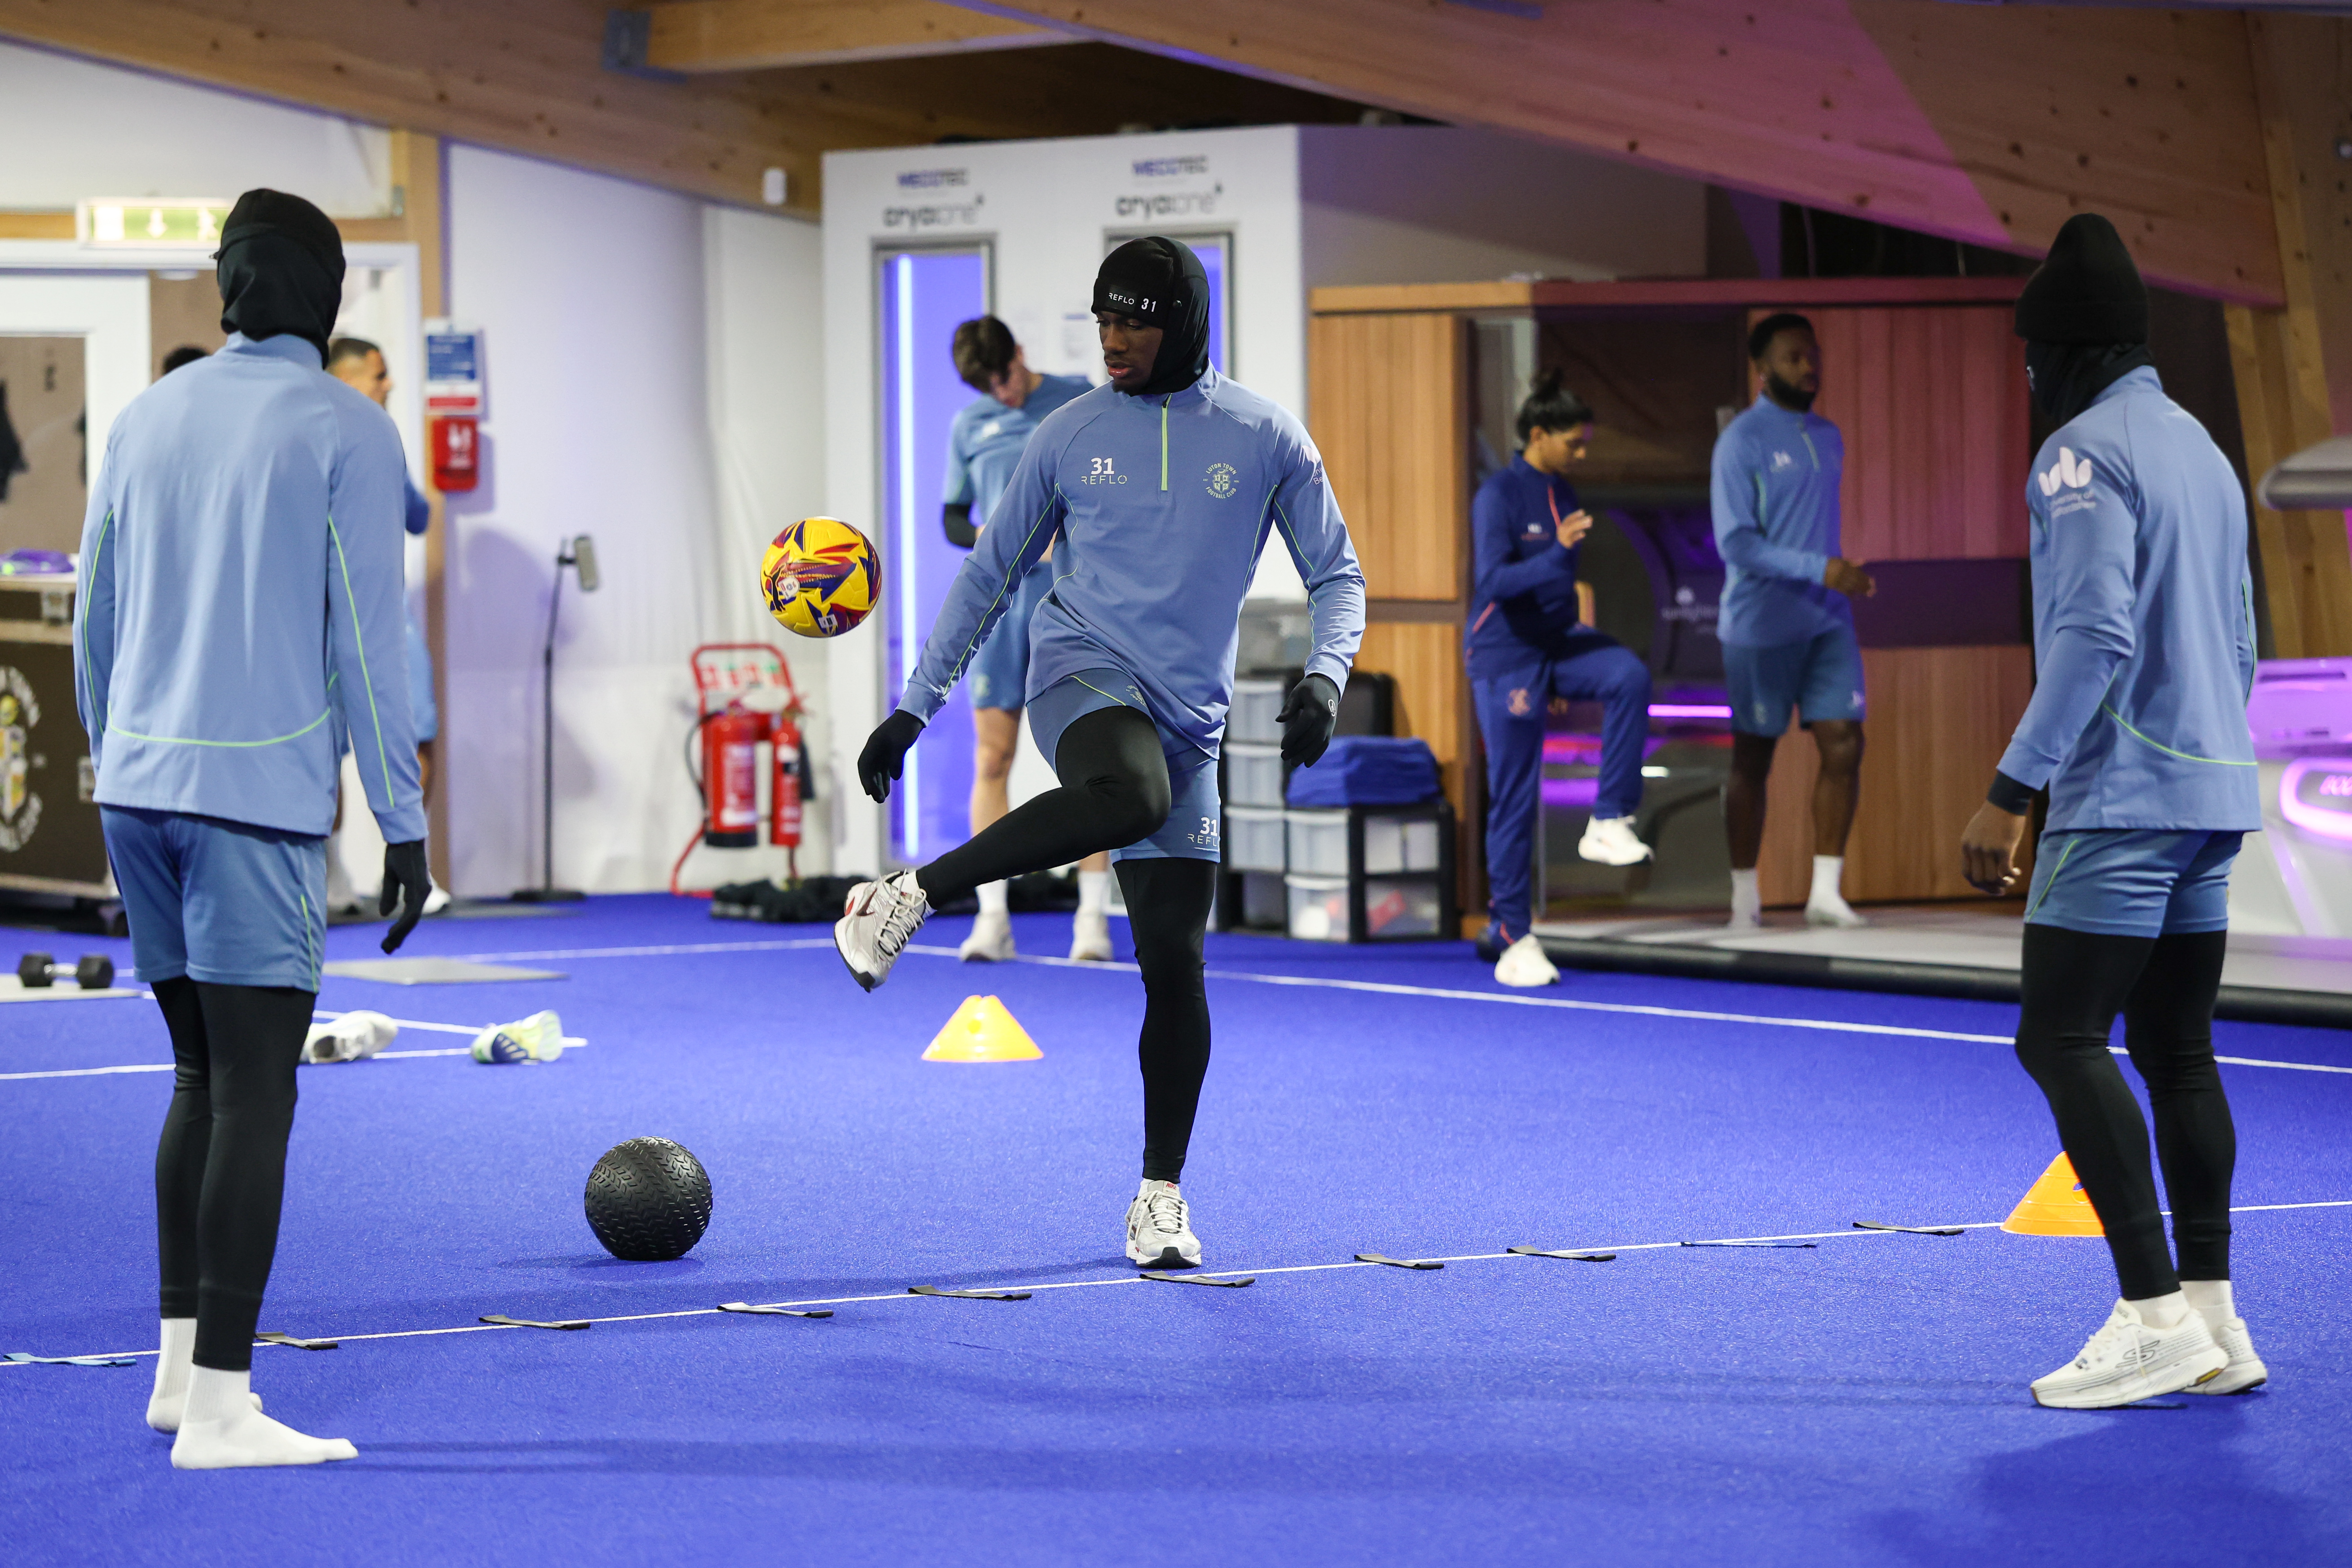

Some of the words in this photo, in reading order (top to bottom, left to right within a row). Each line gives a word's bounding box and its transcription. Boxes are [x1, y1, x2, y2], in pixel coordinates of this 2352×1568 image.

[1108, 293, 1134, 305] REFLO
[1141, 298, 1156, 312] 31
[1090, 457, 1115, 474] 31
[1205, 463, 1221, 474] LUTON
[1223, 463, 1237, 475] TOWN
[1081, 475, 1127, 485] REFLO
[1205, 486, 1226, 499] FOOTBALL
[1226, 488, 1236, 497] CLUB
[1200, 817, 1218, 837] 31
[1166, 1182, 1177, 1190] NIKE
